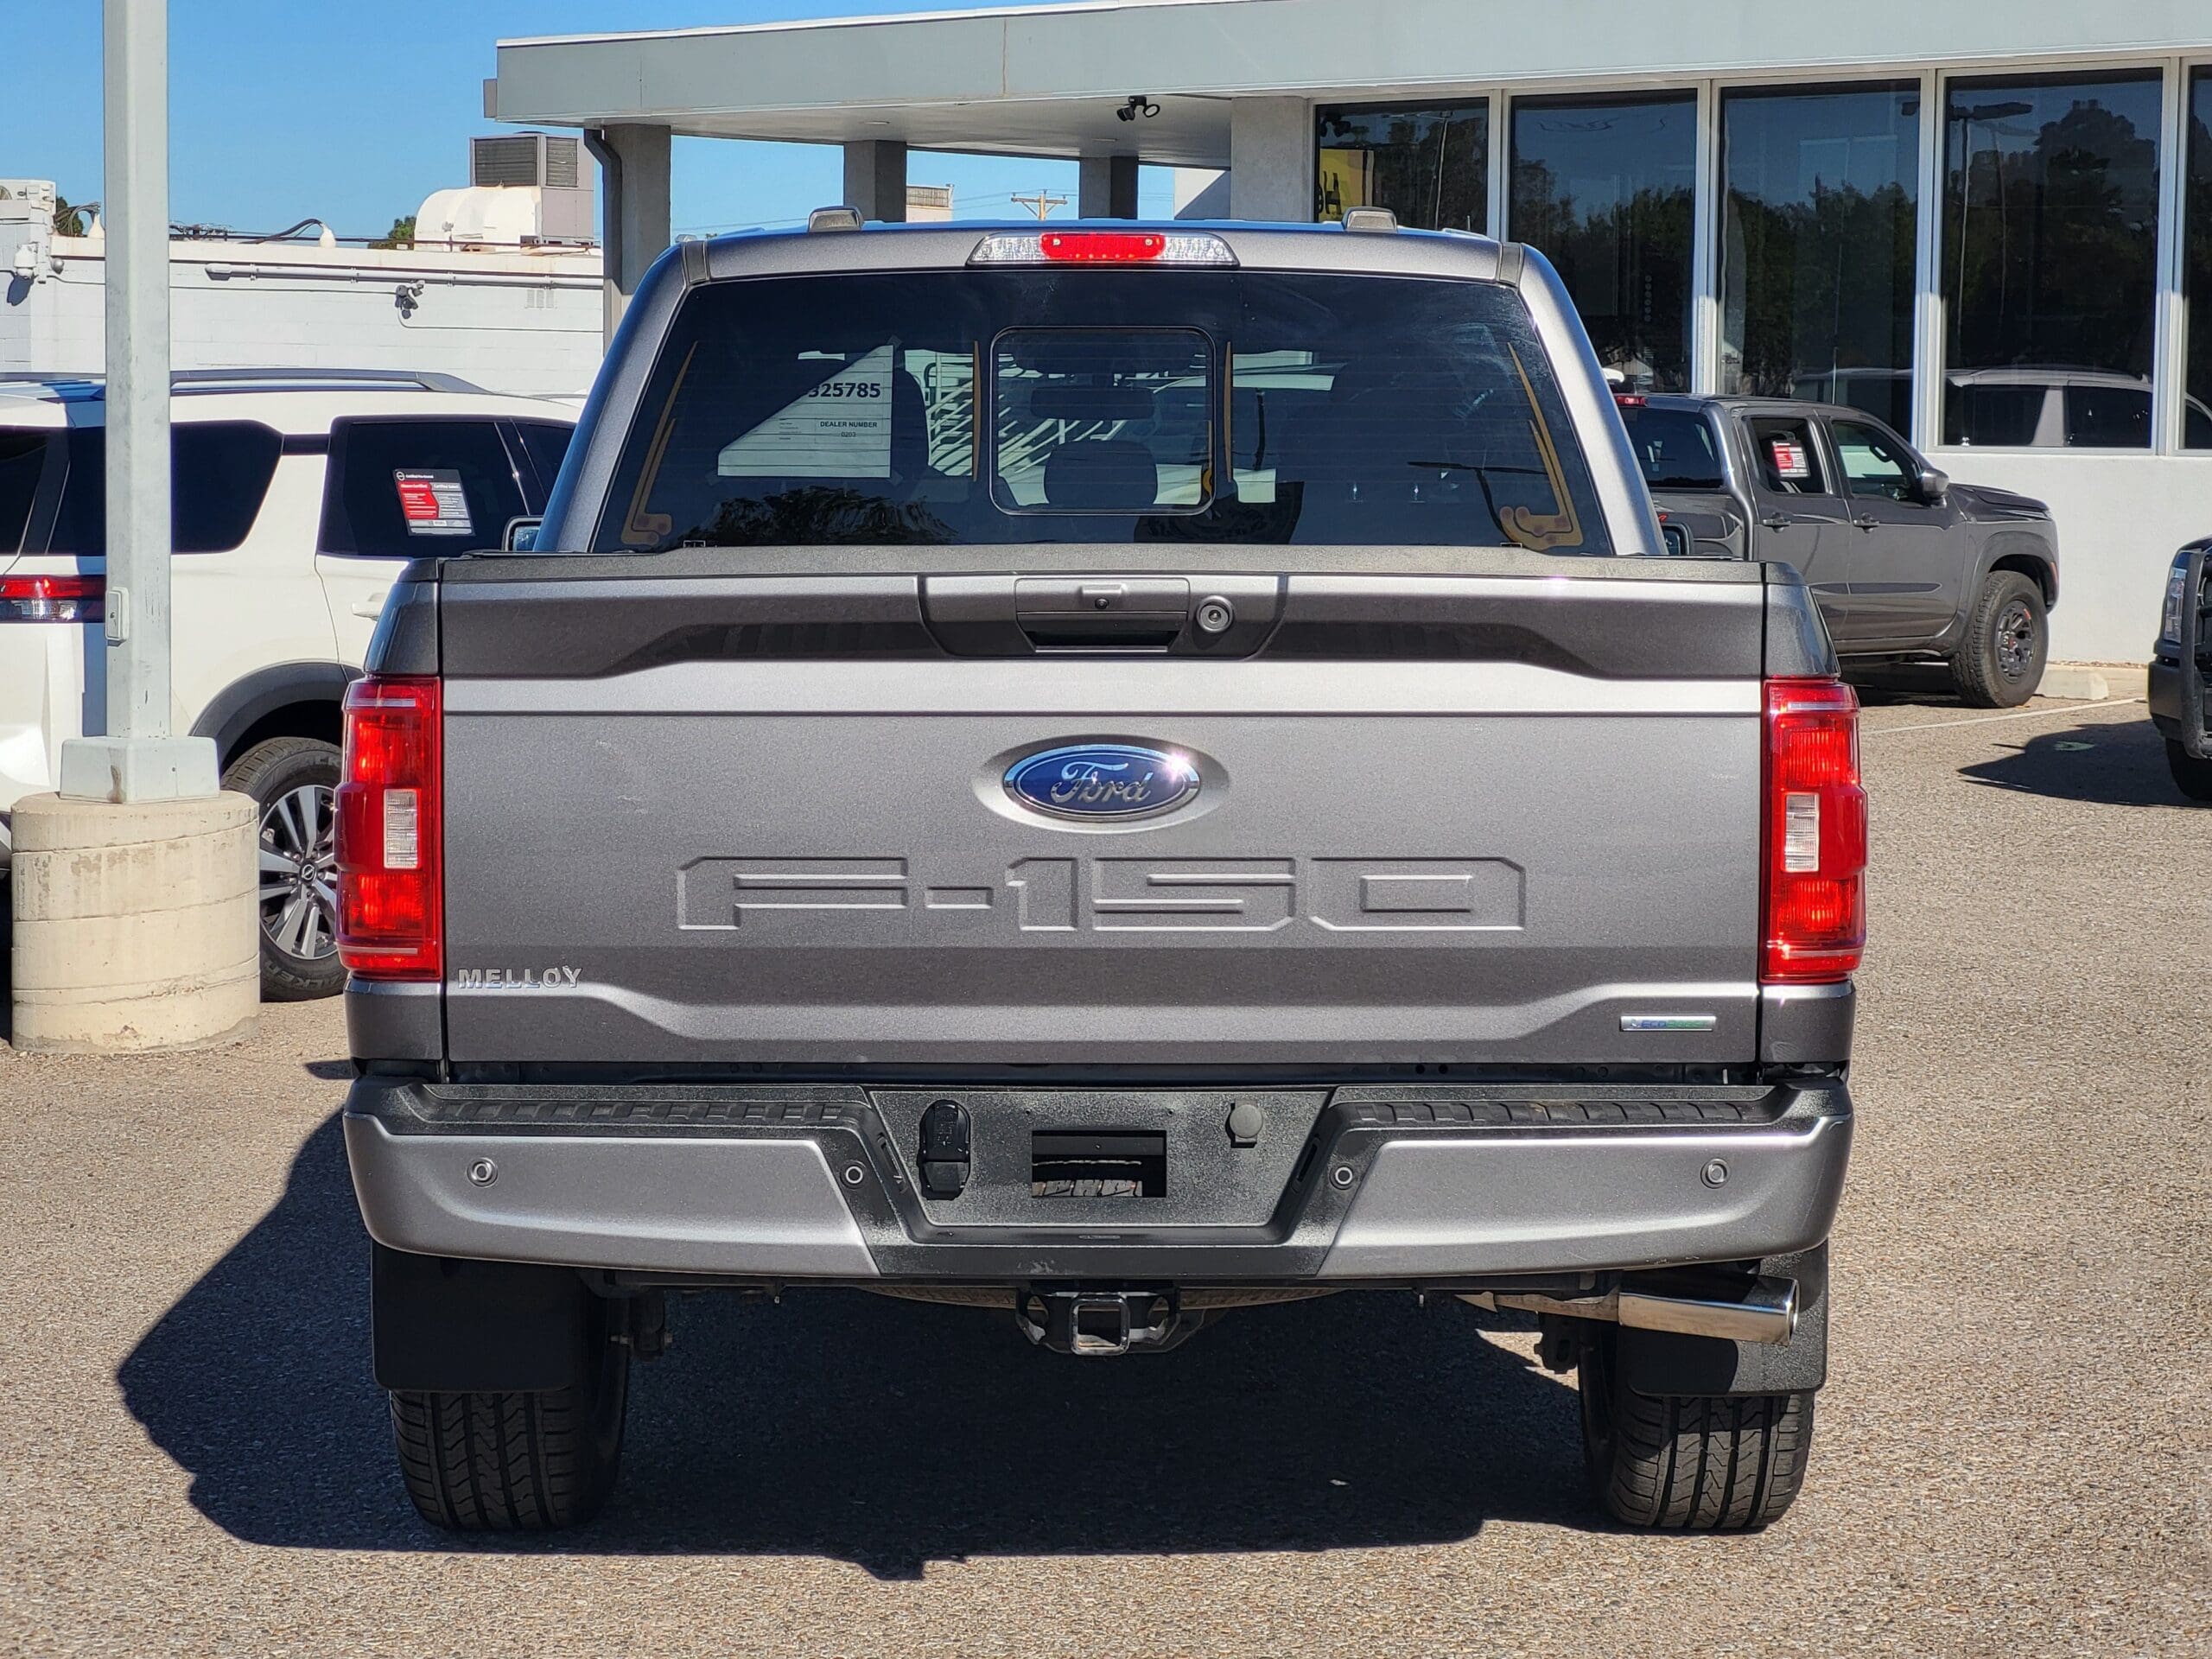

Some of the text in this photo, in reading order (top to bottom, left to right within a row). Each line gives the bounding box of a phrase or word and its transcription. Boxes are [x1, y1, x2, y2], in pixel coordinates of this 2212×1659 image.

[1050, 760, 1154, 804] Ford
[677, 856, 1527, 931] F-150
[458, 965, 583, 989] MELLOY
